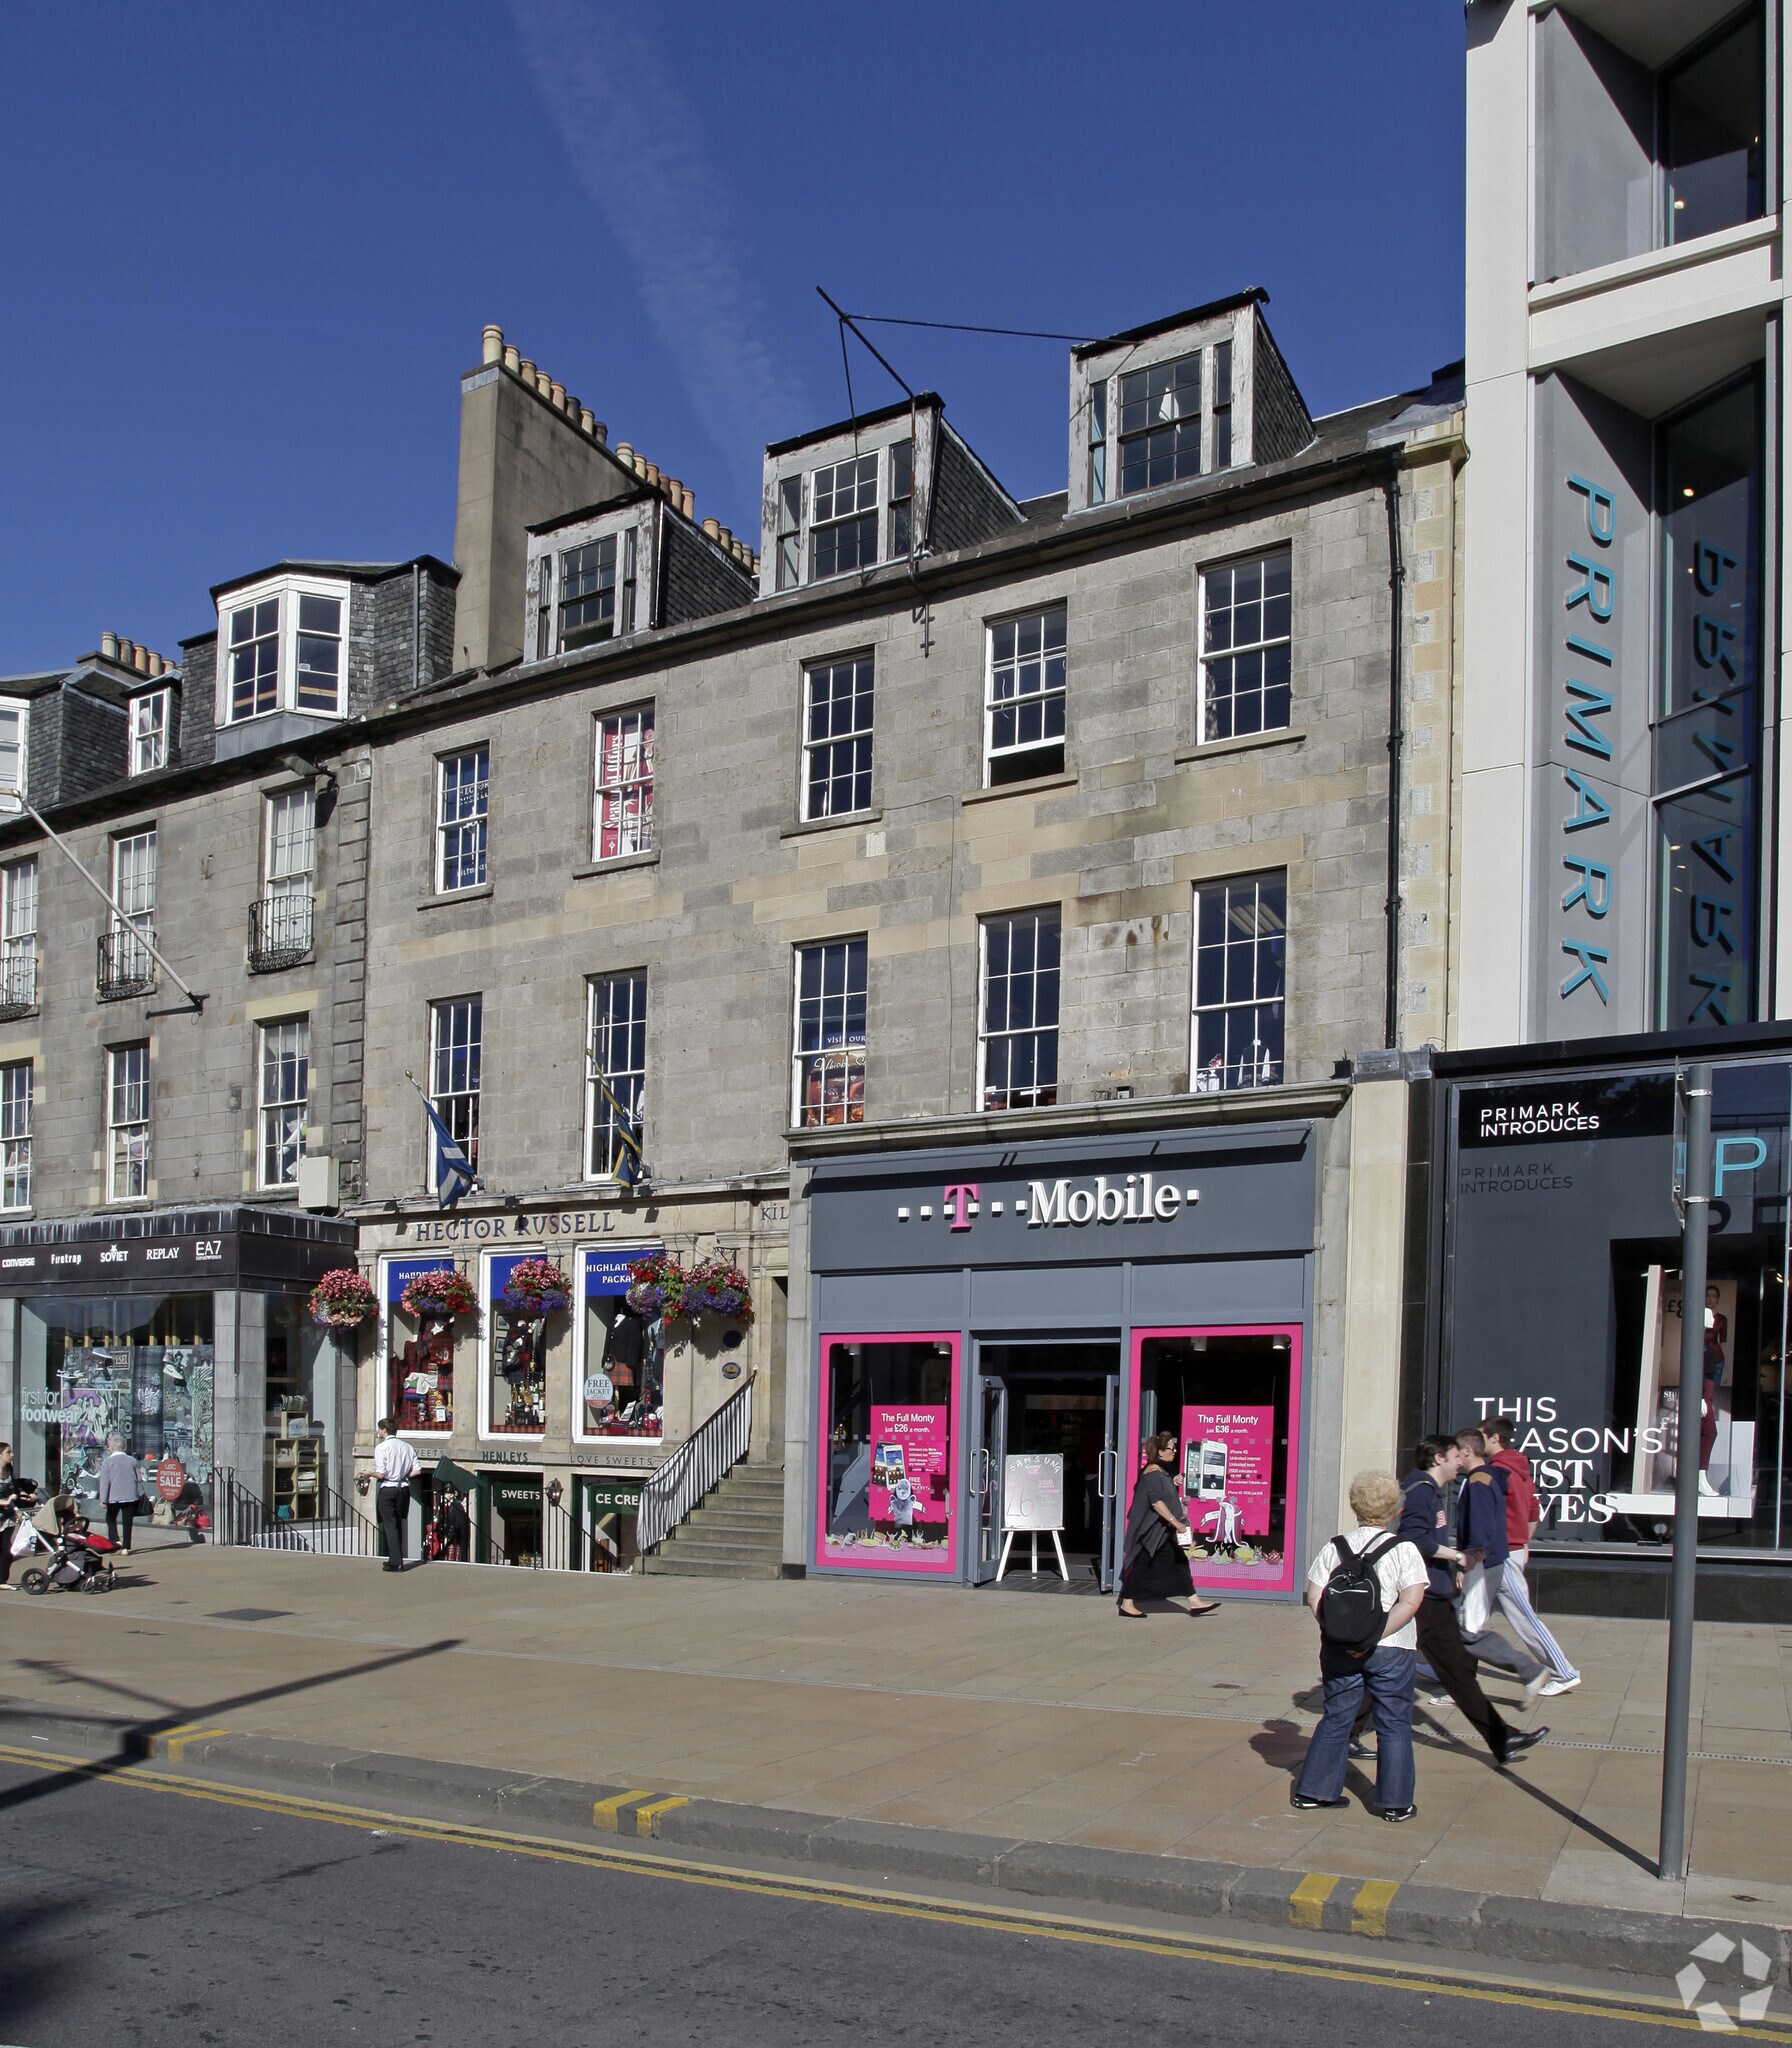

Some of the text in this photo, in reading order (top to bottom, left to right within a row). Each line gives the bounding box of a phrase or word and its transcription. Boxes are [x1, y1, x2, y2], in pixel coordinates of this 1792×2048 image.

[1565, 472, 1617, 1006] PRIMARK
[1480, 1102, 1581, 1123] PRIMARK
[1480, 1115, 1600, 1138] INTRODUCES
[1714, 1137, 1767, 1197] P
[1027, 1173, 1183, 1226] Mobile
[761, 1203, 790, 1220] KIL
[416, 1212, 616, 1242] HECTOR RUSSELL
[146, 1246, 180, 1260] REPLAY
[195, 1240, 222, 1256] EA7
[2, 1257, 36, 1268] CONVERSE
[51, 1254, 81, 1265] Firetrap
[100, 1250, 129, 1263] SOVIET
[586, 1263, 631, 1272] HIGHLAN
[587, 1379, 611, 1388] FREE
[21, 1386, 60, 1405] first for
[586, 1388, 611, 1396] JACKET
[21, 1404, 80, 1424] footwear
[1474, 1397, 1557, 1423] THIS
[881, 1413, 935, 1424] The Full Monty
[1197, 1414, 1259, 1425] The Full Monty
[894, 1424, 908, 1433] £26
[1215, 1425, 1230, 1434] £36
[1510, 1427, 1663, 1454] ASON'S
[414, 1449, 445, 1457] EETS
[482, 1451, 529, 1462] HENLEYS
[570, 1455, 653, 1466] LOVE SWEETS
[1009, 1456, 1061, 1474] SAMSUNG
[160, 1476, 182, 1487] SALE
[501, 1489, 541, 1500] SWEETS
[595, 1493, 639, 1506] CE CRE
[1533, 1493, 1616, 1524] VES
